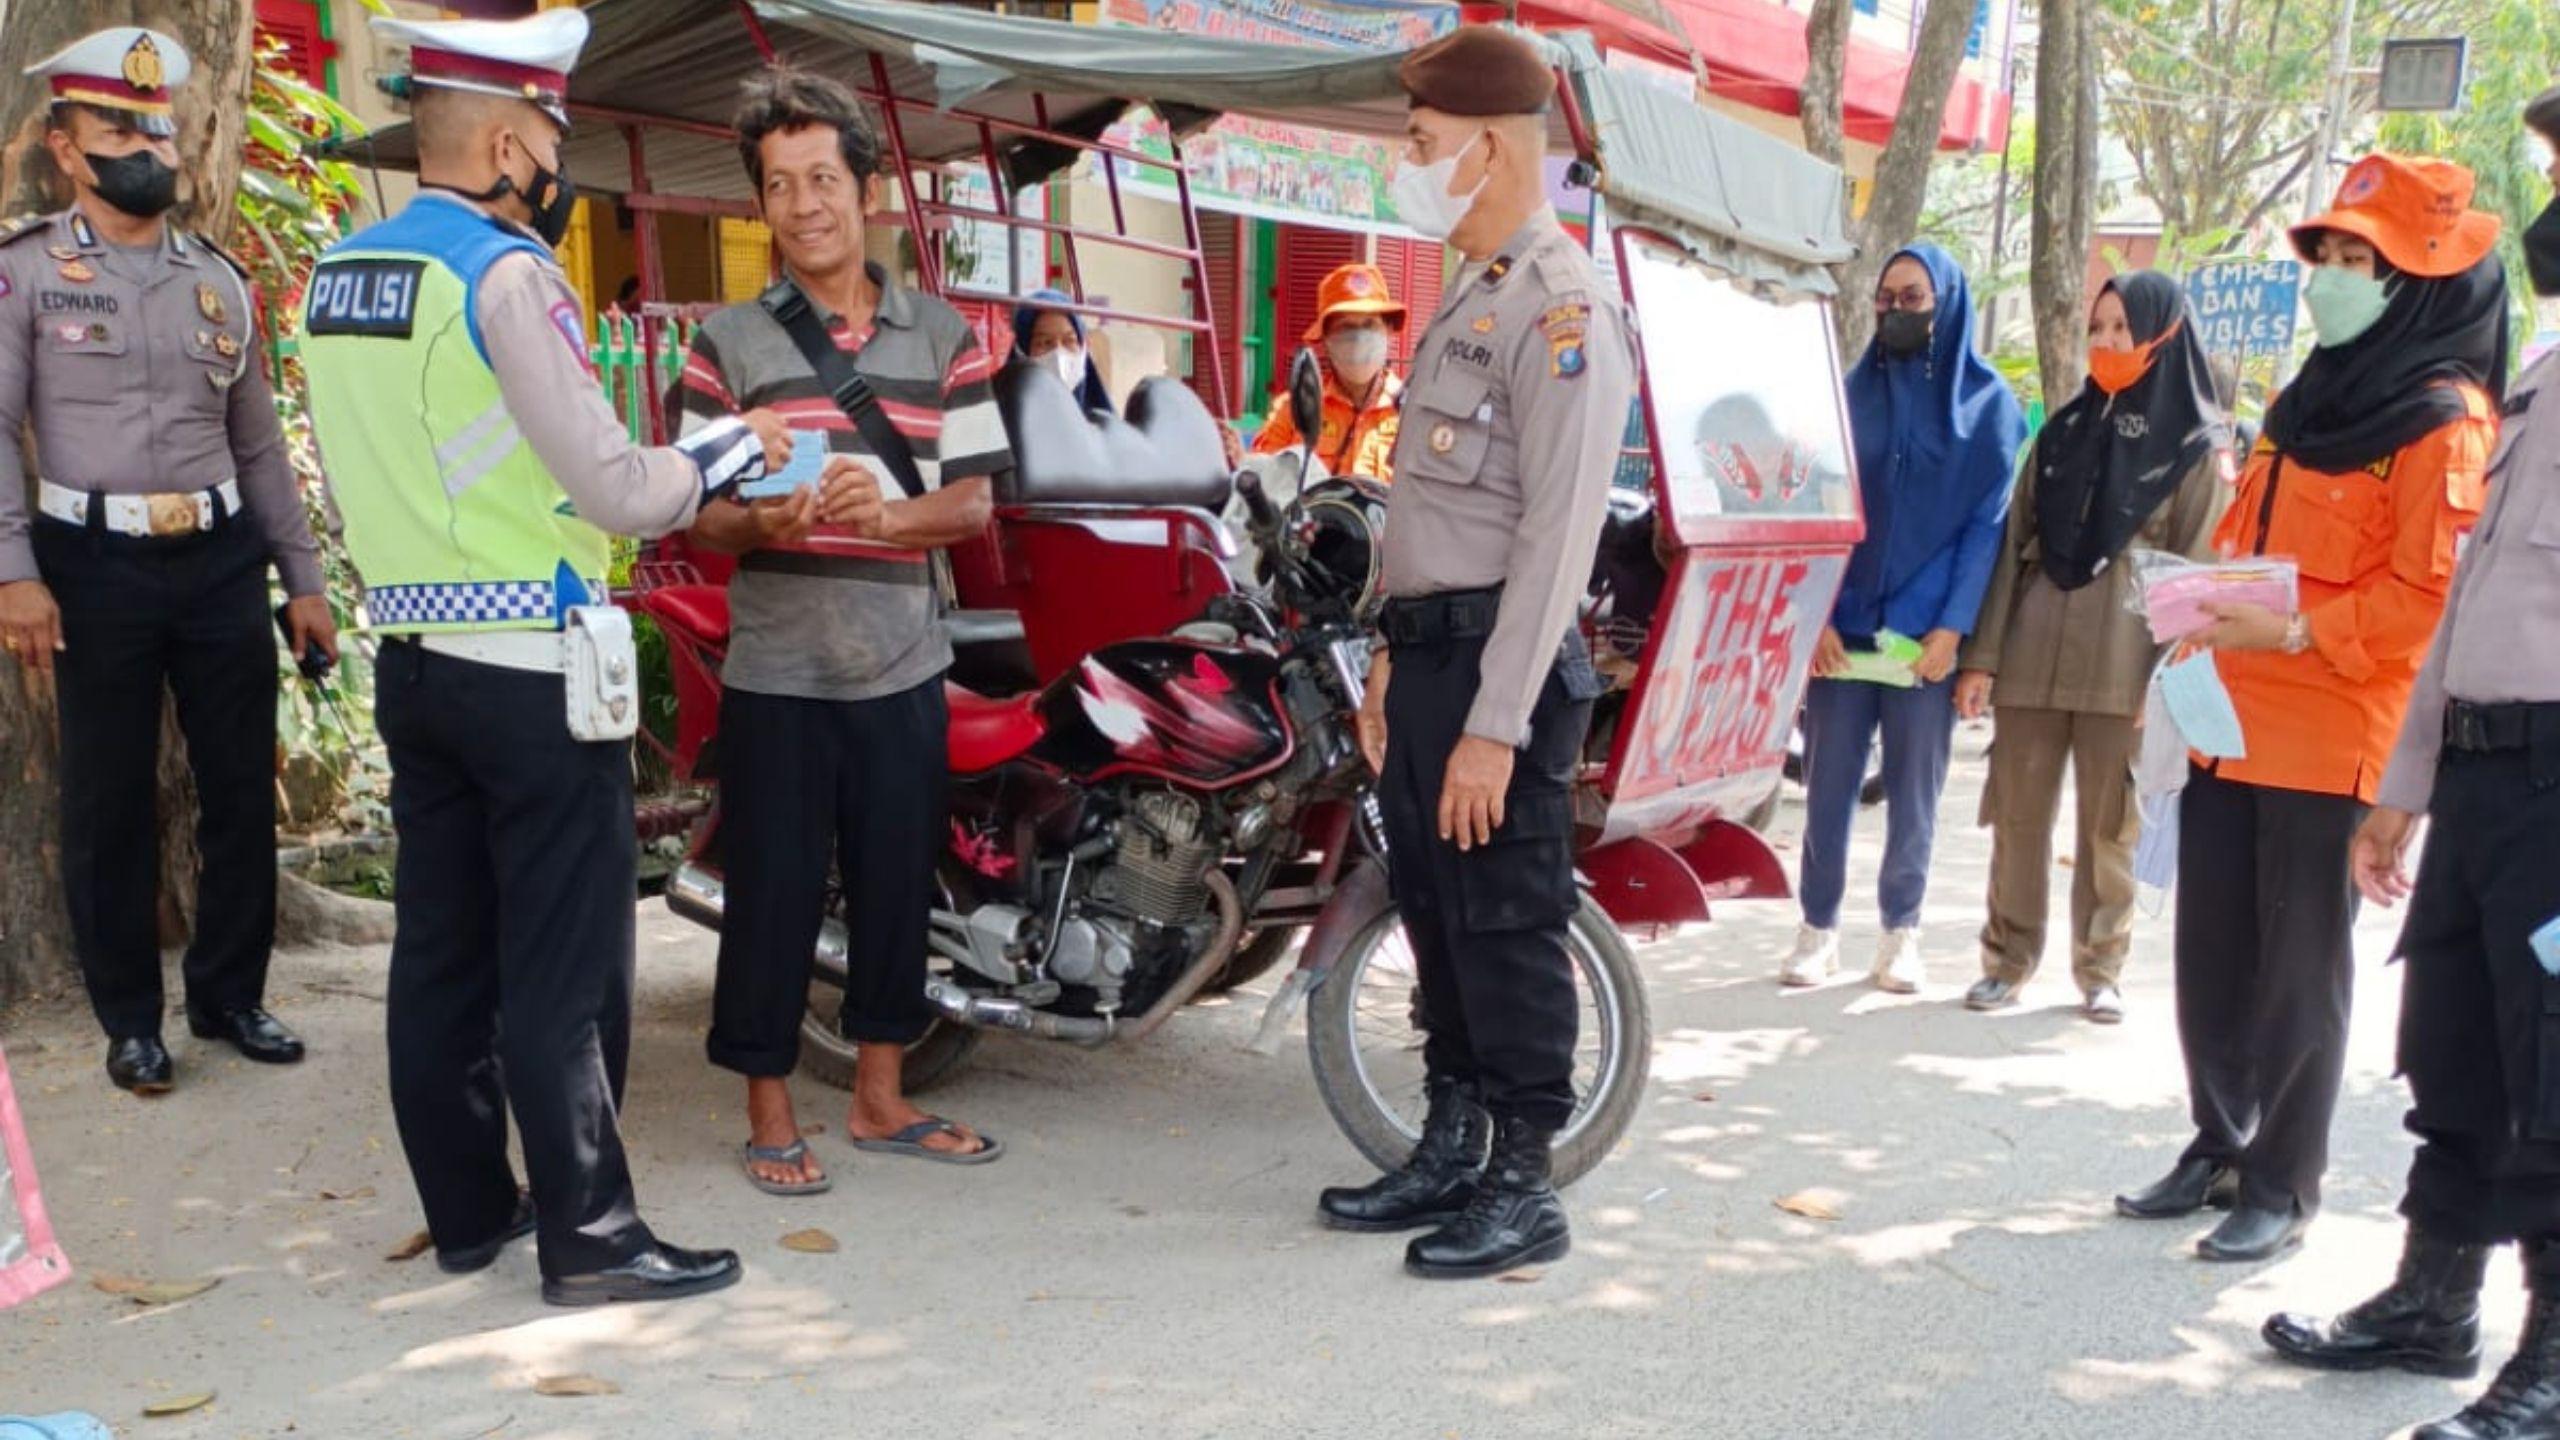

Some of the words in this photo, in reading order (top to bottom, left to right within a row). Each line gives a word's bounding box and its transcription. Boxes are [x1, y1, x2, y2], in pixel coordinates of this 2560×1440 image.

[41, 291, 118, 314] EDWARD
[310, 271, 414, 319] POLISI
[2201, 285, 2261, 315] BAN
[1693, 562, 1809, 659] THE
